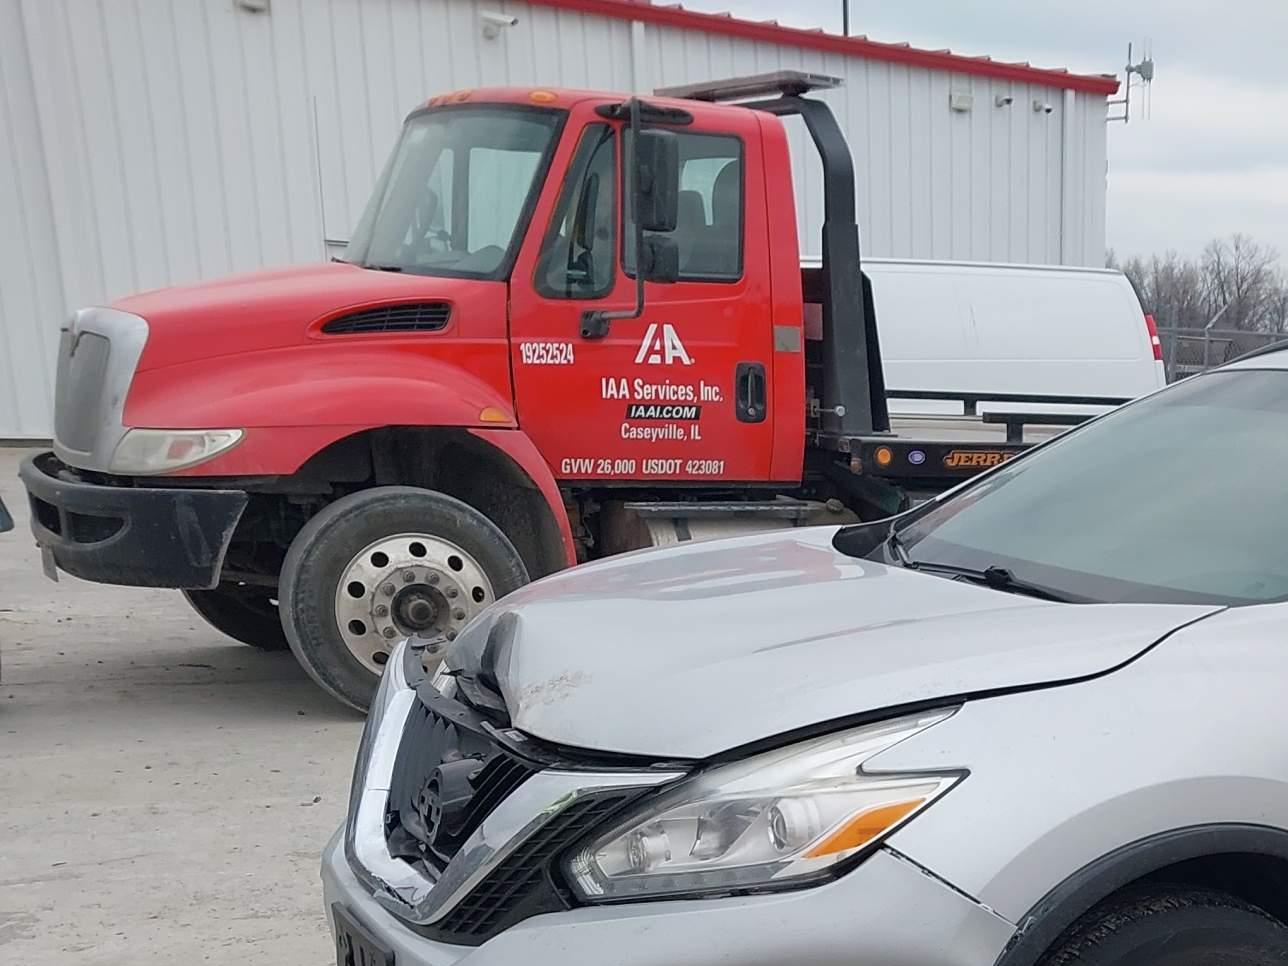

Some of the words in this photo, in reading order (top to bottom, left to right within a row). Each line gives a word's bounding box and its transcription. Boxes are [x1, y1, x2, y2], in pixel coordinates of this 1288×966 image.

[520, 342, 574, 364] 19252524
[601, 377, 630, 399] IAA
[634, 378, 698, 403] Services,
[700, 380, 724, 402] Inc.
[630, 405, 697, 419] IAAI.COM
[621, 422, 688, 442] Caseyville,
[690, 425, 702, 440] IL
[561, 458, 595, 474] GVW
[596, 459, 636, 476] 26,000
[642, 459, 683, 474] USDOT
[685, 459, 725, 475] 423081
